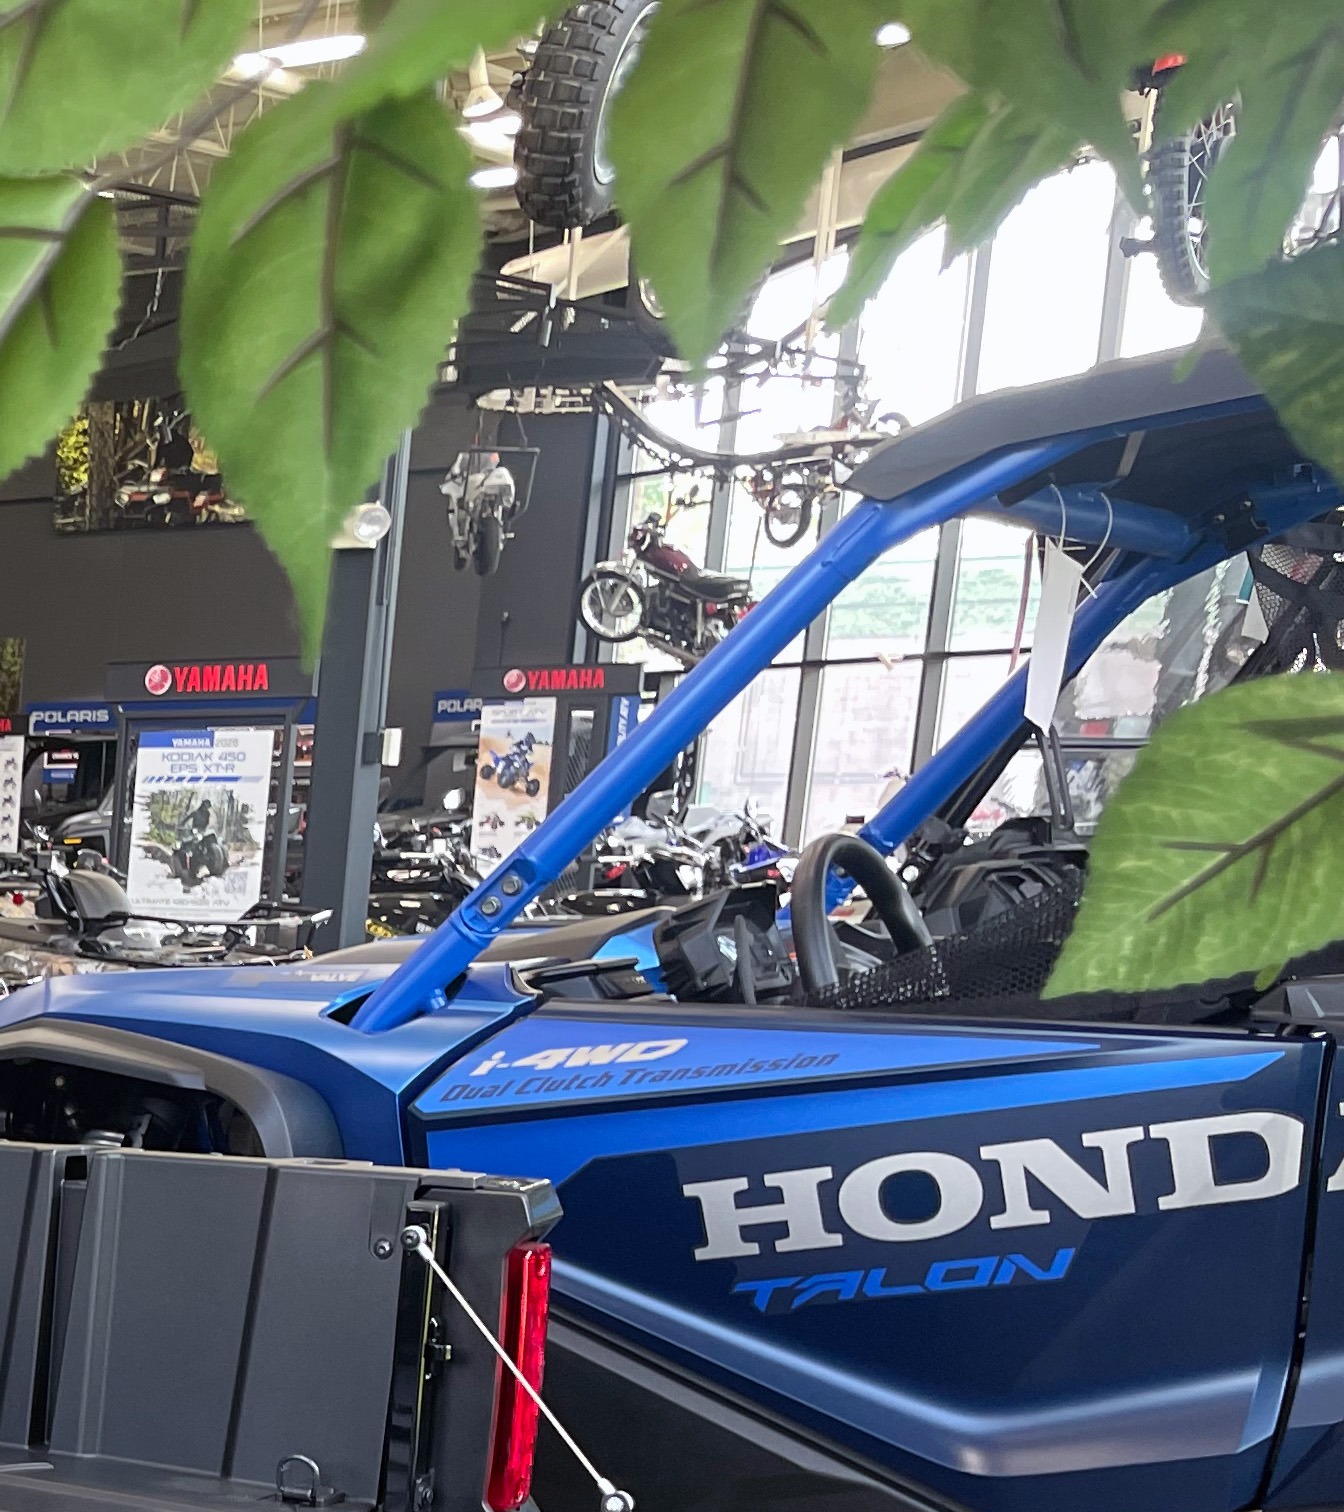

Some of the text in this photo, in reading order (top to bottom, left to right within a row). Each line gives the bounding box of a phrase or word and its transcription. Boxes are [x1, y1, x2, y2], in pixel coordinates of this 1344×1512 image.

[174, 663, 269, 692] YAMAHA
[528, 668, 605, 690] YAMAHA
[32, 709, 109, 724] POLARIS
[437, 698, 483, 714] POLAR
[172, 737, 211, 748] YAMAHA
[161, 751, 246, 762] KODIAK 450
[170, 763, 198, 773] EPS
[469, 1038, 689, 1077] i-4WD
[440, 1052, 840, 1102] Dual Clutch Transmission
[683, 1102, 1344, 1261] HOND
[732, 1248, 1075, 1313] TALON
